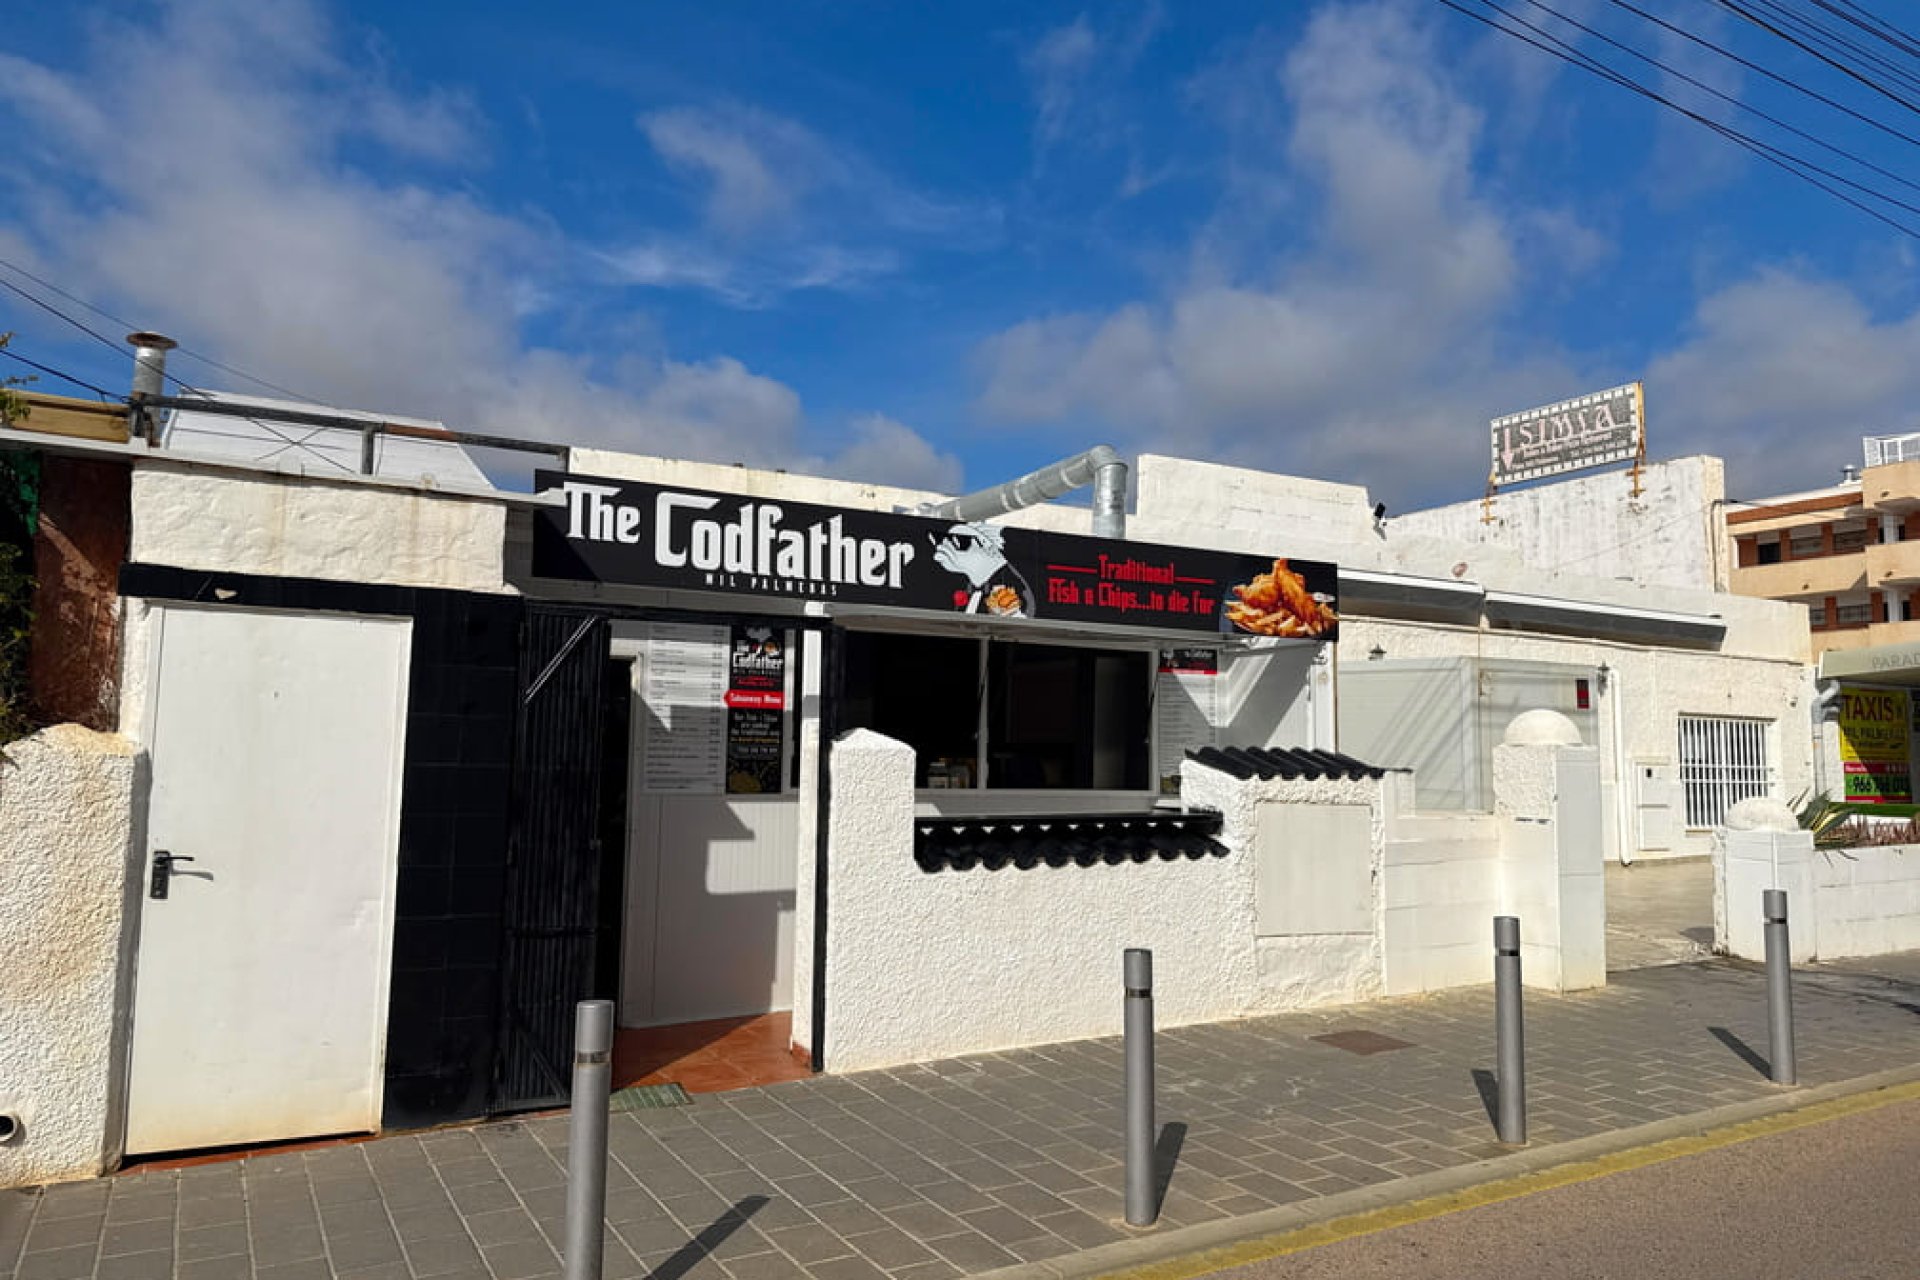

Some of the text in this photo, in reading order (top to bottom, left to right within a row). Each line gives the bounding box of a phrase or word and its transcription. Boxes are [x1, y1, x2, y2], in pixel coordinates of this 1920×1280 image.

[564, 481, 915, 588] The Codfather
[1097, 554, 1175, 584] Traditional
[705, 573, 837, 596] MIL PALMERAS
[1048, 577, 1079, 604] Fish
[1168, 590, 1189, 613] die
[1192, 590, 1216, 614] for
[1842, 695, 1893, 721] TAXIS
